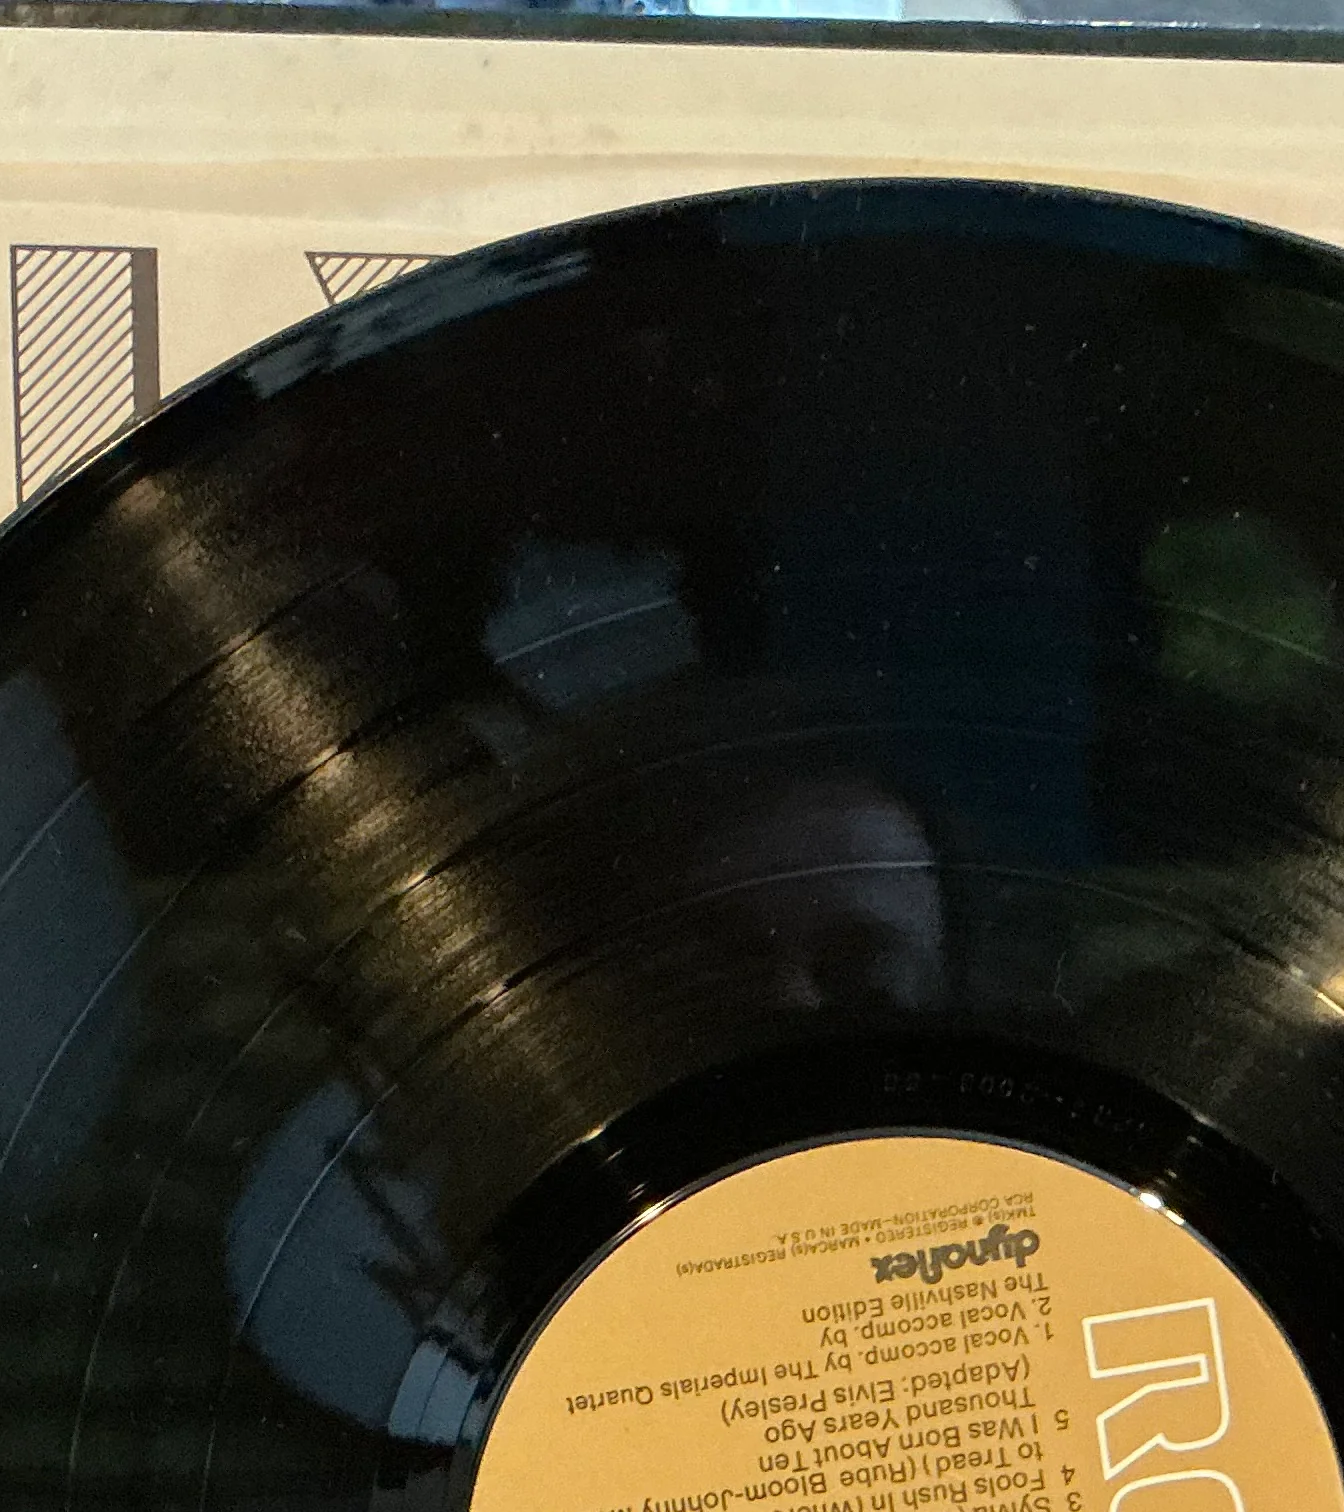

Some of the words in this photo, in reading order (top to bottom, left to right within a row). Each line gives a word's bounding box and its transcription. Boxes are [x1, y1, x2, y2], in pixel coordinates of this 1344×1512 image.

[868, 1222, 1041, 1285] dynaflex
[889, 1278, 998, 1313] Nashville
[1003, 1271, 1050, 1293] The
[800, 1296, 884, 1324] Edition
[852, 1310, 953, 1340] accomp.
[959, 1300, 1027, 1330] Vocal
[818, 1325, 849, 1348] by
[857, 1335, 957, 1366] accomp.
[962, 1324, 1030, 1354] Vocal
[773, 1358, 820, 1381] The
[823, 1350, 853, 1374] by
[900, 1352, 1031, 1398] (Adapted:
[658, 1365, 768, 1401] Imperials
[831, 1378, 896, 1407] Elvis
[564, 1384, 654, 1416] Quartet
[719, 1388, 828, 1428] Presley)
[904, 1385, 1037, 1427] Thousand
[762, 1417, 817, 1444] Ago
[821, 1406, 900, 1434] Years
[966, 1415, 1025, 1441] Was
[811, 1435, 891, 1469] About
[897, 1424, 962, 1451] Born
[1016, 1440, 1044, 1461] to
[757, 1449, 809, 1473] Ten
[838, 1455, 917, 1488] (Rube
[900, 1479, 968, 1511] Rush
[972, 1467, 1046, 1498] Fools
